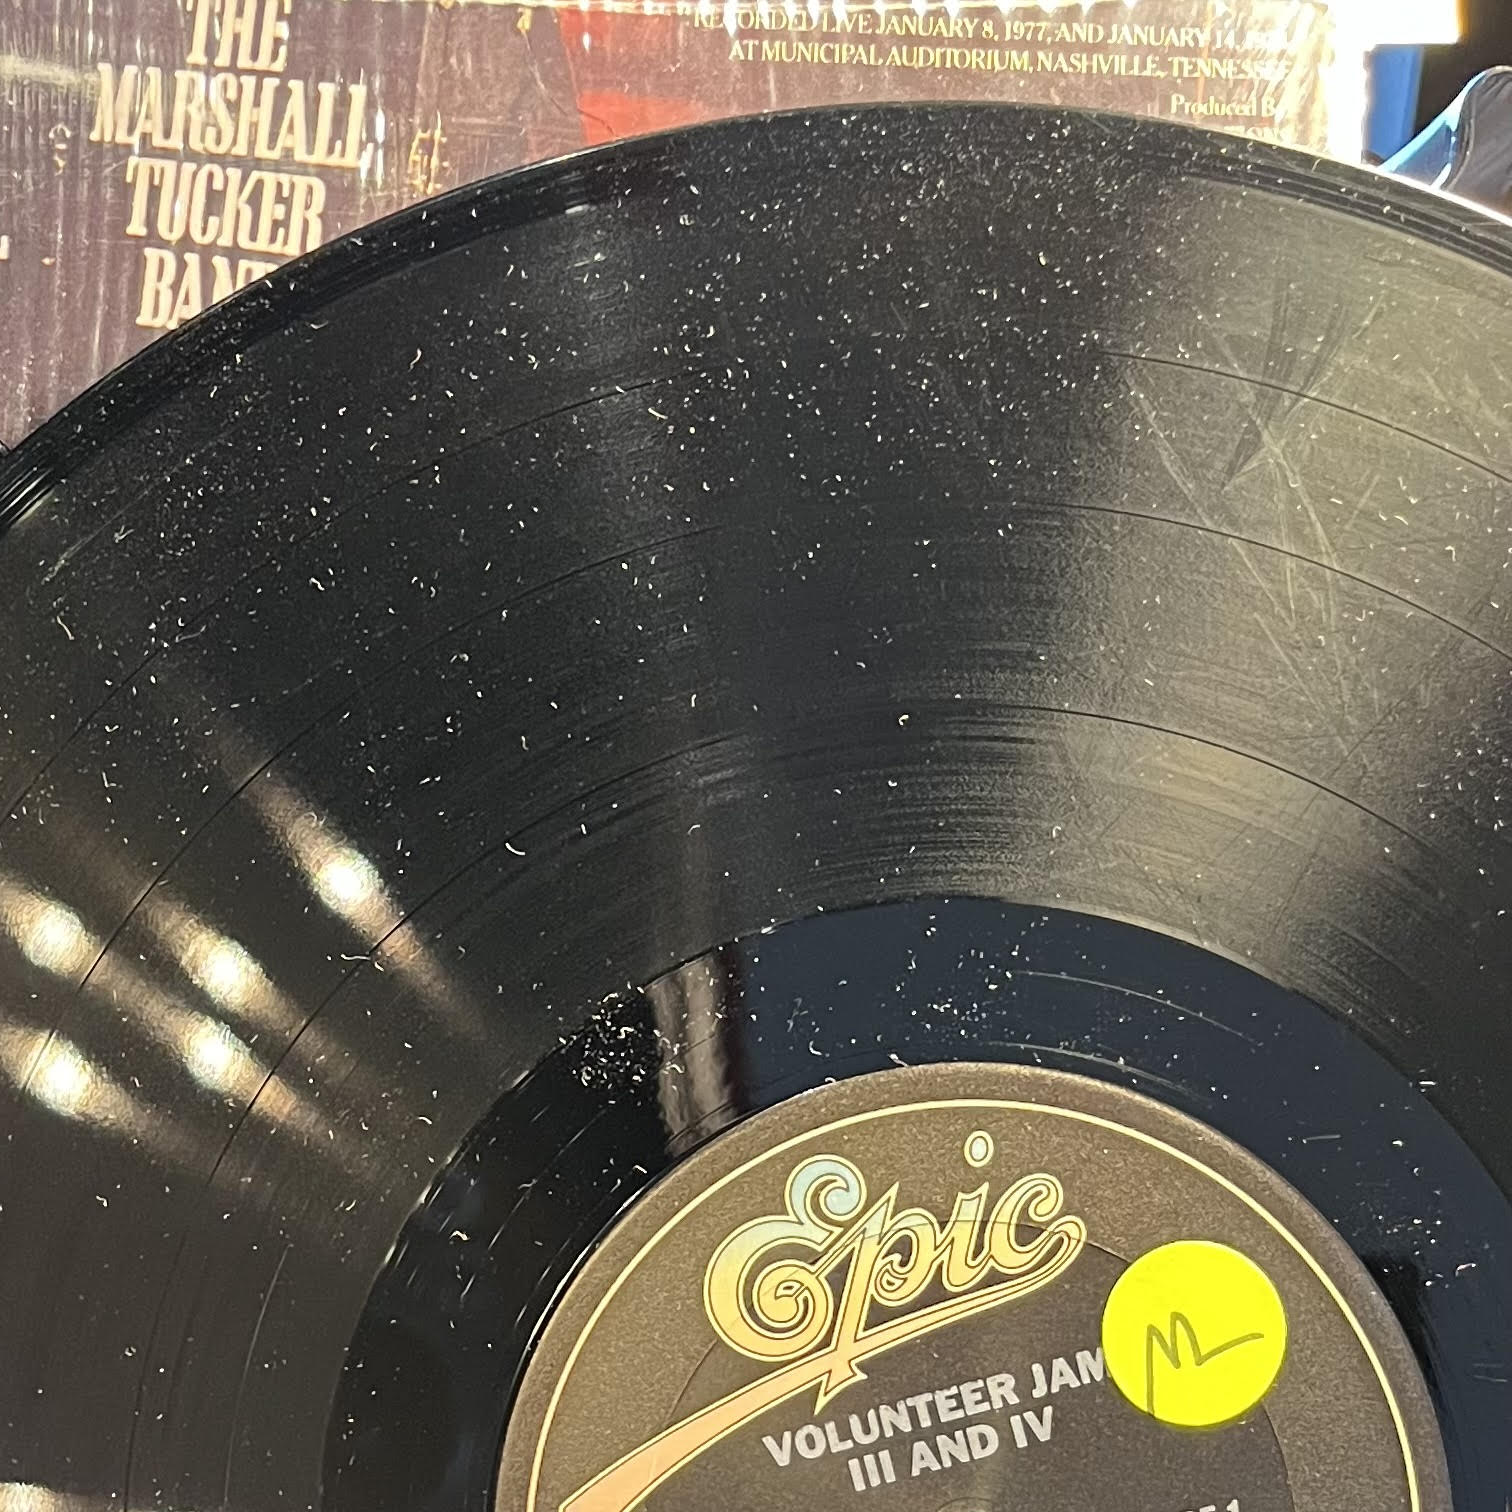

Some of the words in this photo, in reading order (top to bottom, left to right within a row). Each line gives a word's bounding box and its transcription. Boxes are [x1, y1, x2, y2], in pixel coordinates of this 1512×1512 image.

[187, 0, 289, 70] THE
[693, 7, 819, 32] REORDED
[875, 14, 978, 39] JANUARY
[1055, 23, 1103, 44] AND
[1107, 23, 1207, 48] JANUARY
[729, 39, 759, 61] AT
[761, 39, 884, 66] MUNICIPAL
[886, 45, 1033, 74] AUDITORIUM,
[88, 62, 373, 169] MARSHALL
[1171, 94, 1257, 118] Produced
[124, 156, 328, 256] TUCKER
[136, 246, 277, 331] BAN
[761, 1372, 1020, 1467] VOLUNTEER
[846, 1450, 896, 1492] III
[911, 1420, 1000, 1477] AND
[1009, 1405, 1053, 1449] IV
